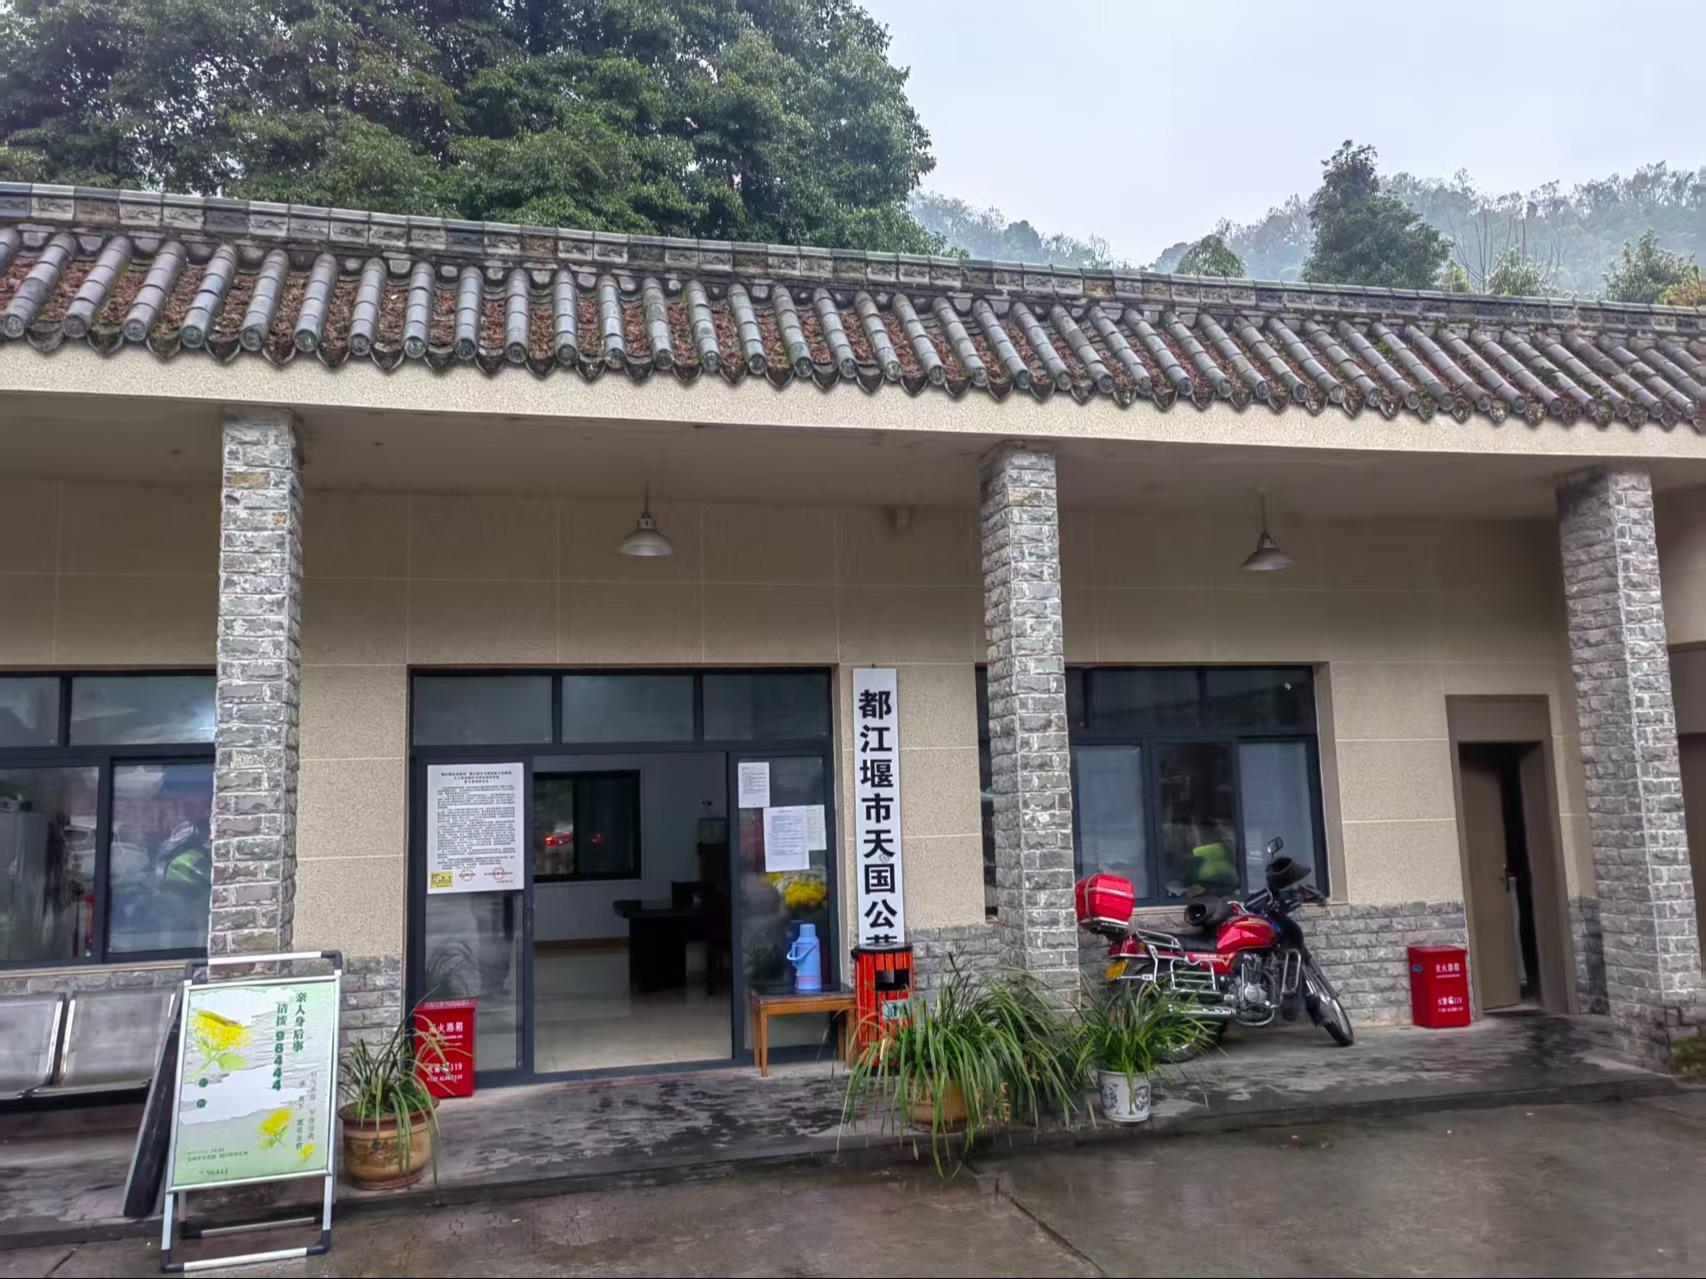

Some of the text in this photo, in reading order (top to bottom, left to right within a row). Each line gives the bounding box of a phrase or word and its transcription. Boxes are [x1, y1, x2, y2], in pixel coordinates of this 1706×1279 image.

[858, 689, 898, 943] 都江堰市天国公
[293, 992, 307, 1053] 亲人身后事
